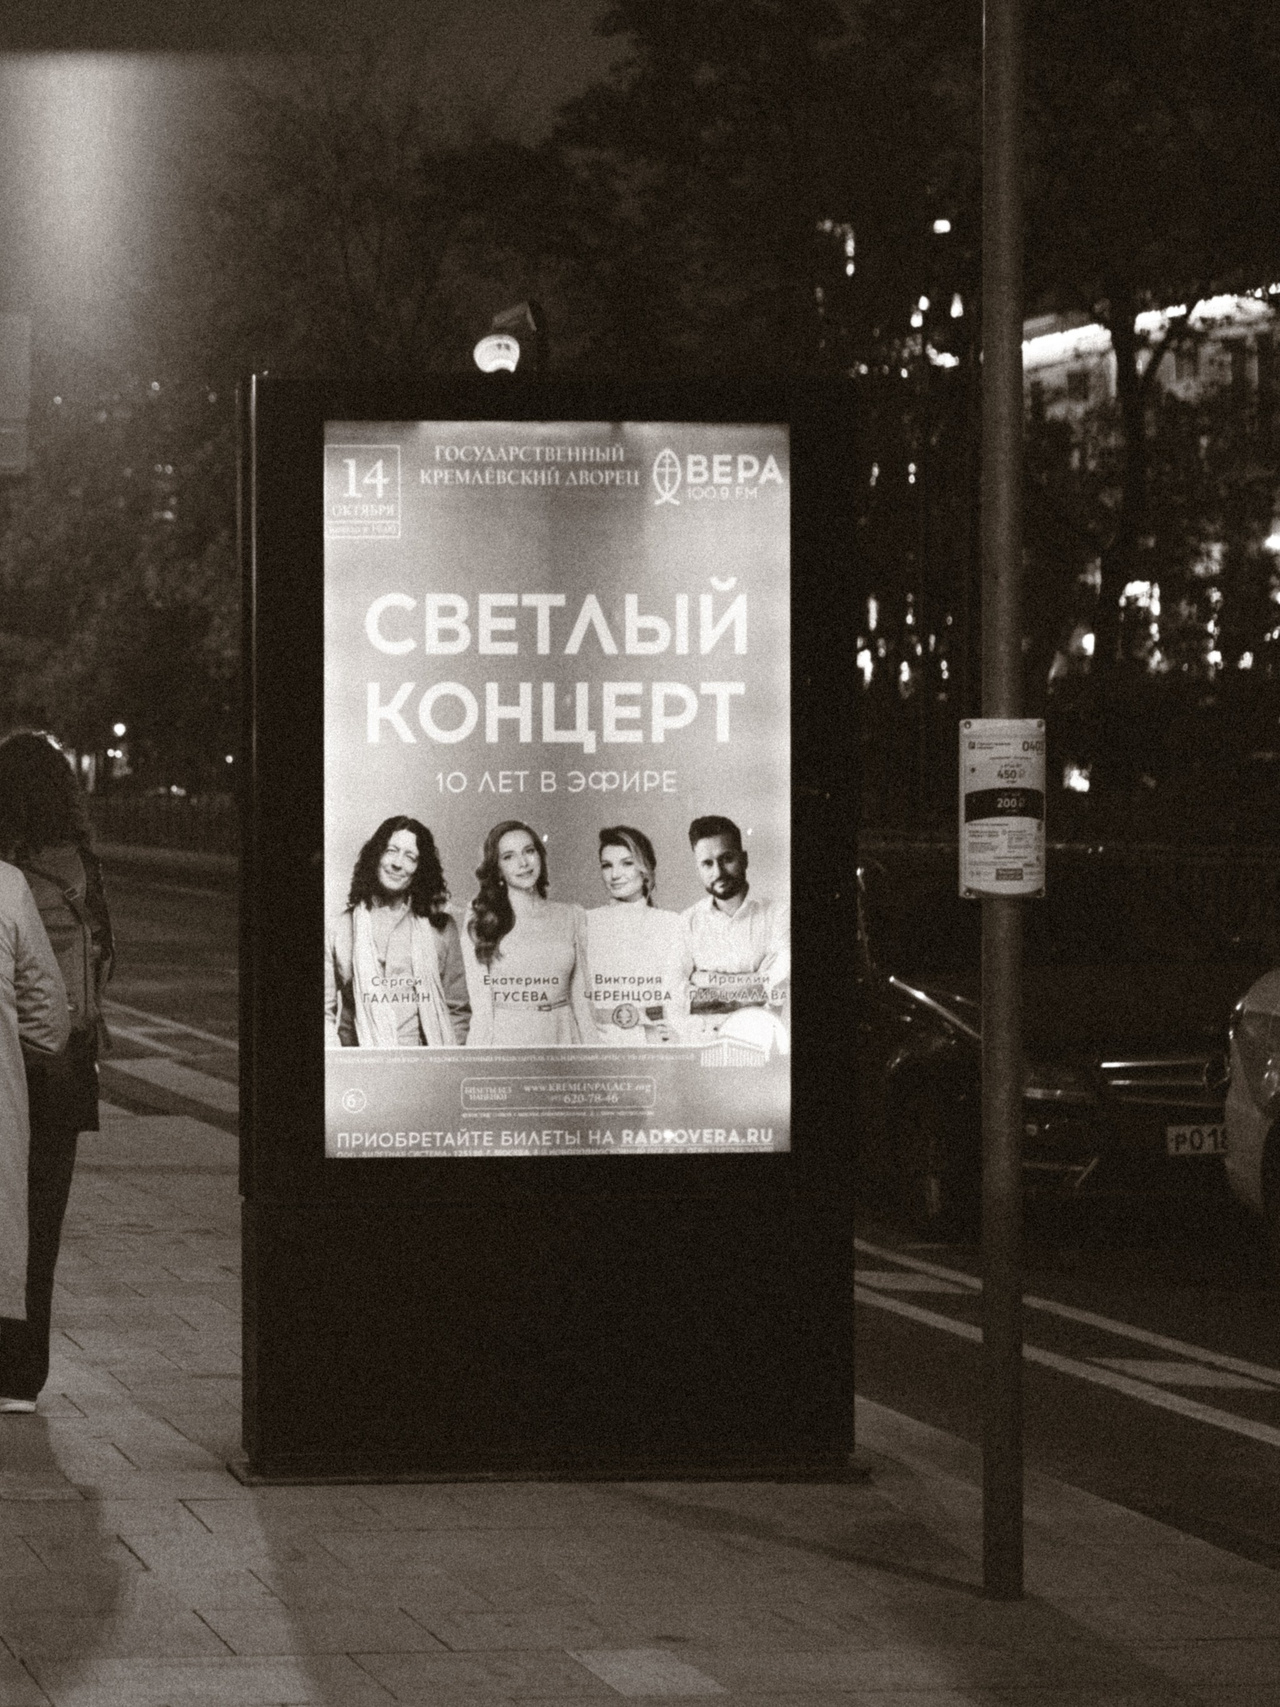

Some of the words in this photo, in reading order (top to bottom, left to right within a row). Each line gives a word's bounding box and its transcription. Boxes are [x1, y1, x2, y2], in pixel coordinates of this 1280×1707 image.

[434, 444, 625, 462] ГОСУДАРСТВЕННЫЙ
[686, 454, 783, 484] ВЕРА
[342, 458, 390, 499] 14
[565, 468, 640, 486] ДВОРЕЦ
[735, 486, 758, 499] FM
[364, 576, 748, 655] СВЕТЛЫЙ
[366, 681, 746, 754] КОНЦЕРТ
[435, 771, 468, 793] 10
[477, 771, 530, 793] ЛЕТ
[540, 771, 558, 793] В
[567, 770, 678, 793] ЭФИРЕ
[997, 769, 1017, 780] 450
[996, 798, 1017, 809] 200
[371, 974, 422, 989] Сергей
[483, 975, 560, 988] Екатерина
[594, 974, 663, 987] Виктория
[363, 992, 431, 1004] ГАЛАНИН
[493, 990, 549, 1003] ГУСЕВА
[583, 990, 673, 1003] ЧЕРЕНЦОВА
[336, 1127, 494, 1148] ПРИОБРЕТАЙТЕ
[500, 1129, 581, 1147] БИЛЕТЫ
[588, 1129, 615, 1146] НА
